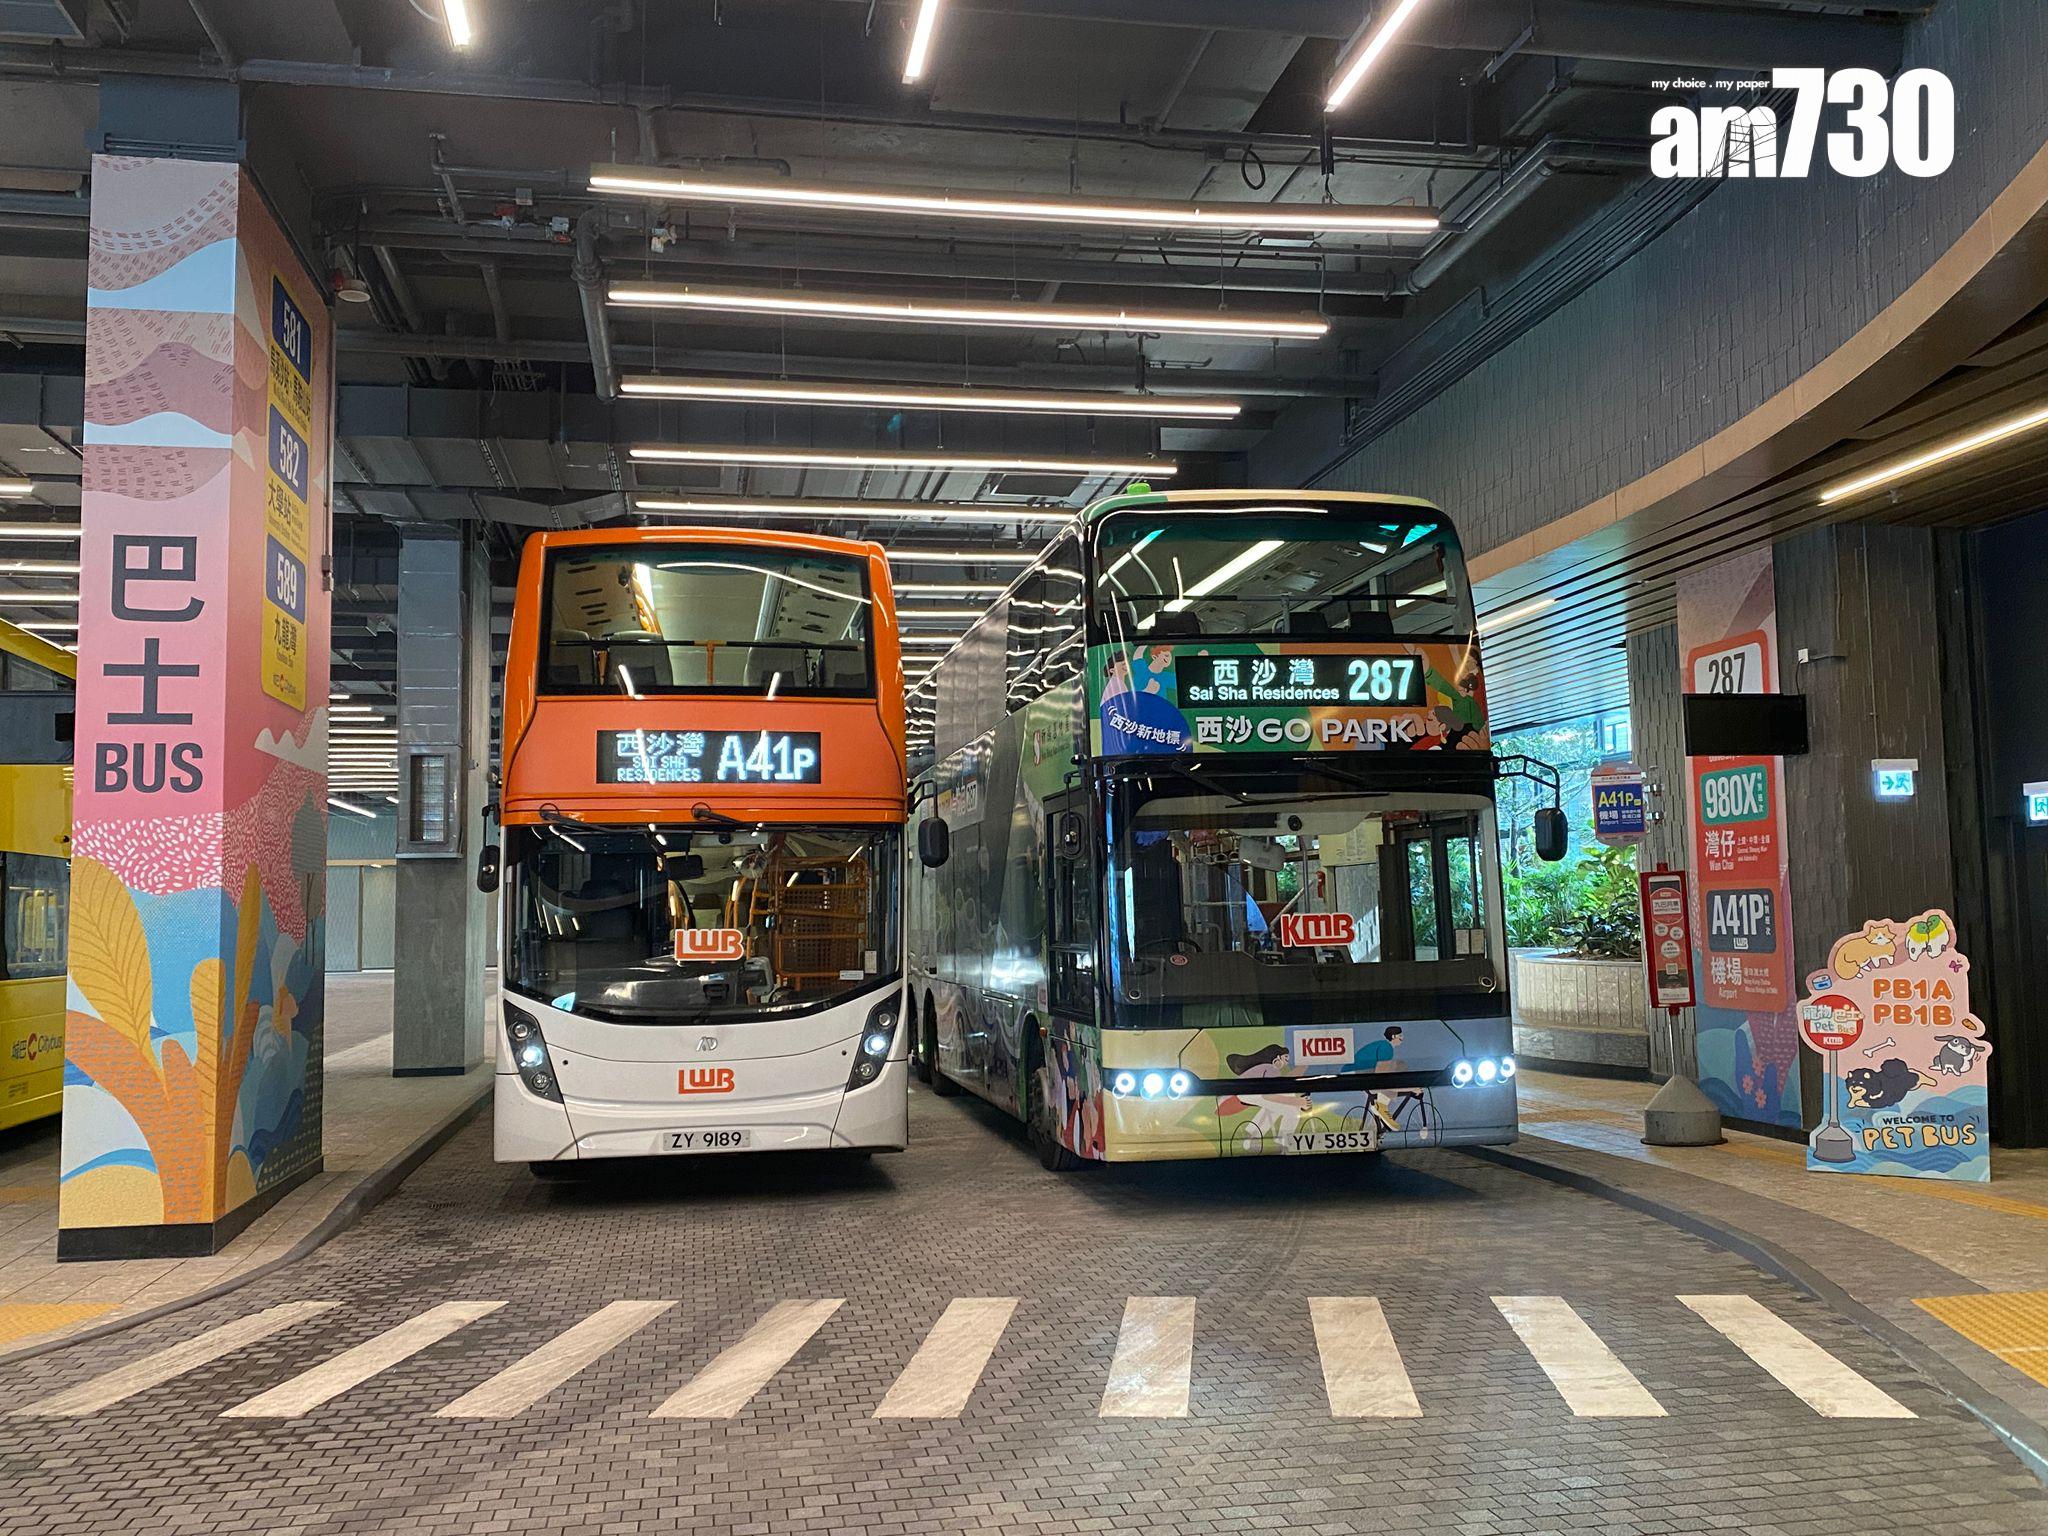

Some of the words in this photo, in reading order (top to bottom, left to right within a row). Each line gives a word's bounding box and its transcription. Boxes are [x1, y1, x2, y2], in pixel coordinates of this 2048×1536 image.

[283, 300, 301, 364] 581
[280, 425, 299, 488] 582
[277, 552, 297, 610] 589
[103, 534, 205, 725] 巴士
[1212, 659, 1315, 685] 西沙灣
[1348, 660, 1414, 700] 287
[1708, 652, 1745, 694] 287
[1189, 686, 1214, 700] Sai
[1217, 686, 1248, 700] Sha
[1252, 685, 1340, 700] Residences
[1321, 718, 1413, 743] PARK
[95, 742, 204, 793] BUS
[661, 756, 687, 768] SHA
[716, 734, 815, 781] A41P
[616, 768, 701, 782] RESIDENCES
[1598, 791, 1634, 808] A41P
[1705, 772, 1758, 818] 980X
[1705, 829, 1735, 857] 灣仔
[1712, 893, 1764, 936] A41P
[1281, 913, 1355, 947] KMB
[675, 928, 745, 961] LWB
[1711, 956, 1742, 985] 機場
[1872, 978, 1954, 1001] PB1A
[1814, 1021, 1834, 1032] Pet
[1837, 1024, 1855, 1035] Bus
[1872, 1003, 1955, 1027] PB1B
[1302, 1037, 1346, 1057] KMB
[678, 1068, 735, 1094] LWB
[1882, 1115, 1937, 1125] WELCOME
[1939, 1114, 1955, 1123] TO
[671, 1133, 694, 1148] ZY
[702, 1131, 742, 1147] 9189
[1293, 1134, 1315, 1150] YV
[1324, 1132, 1370, 1149] 5853
[1862, 1126, 1915, 1150] PET
[1922, 1123, 1976, 1147] BUS
